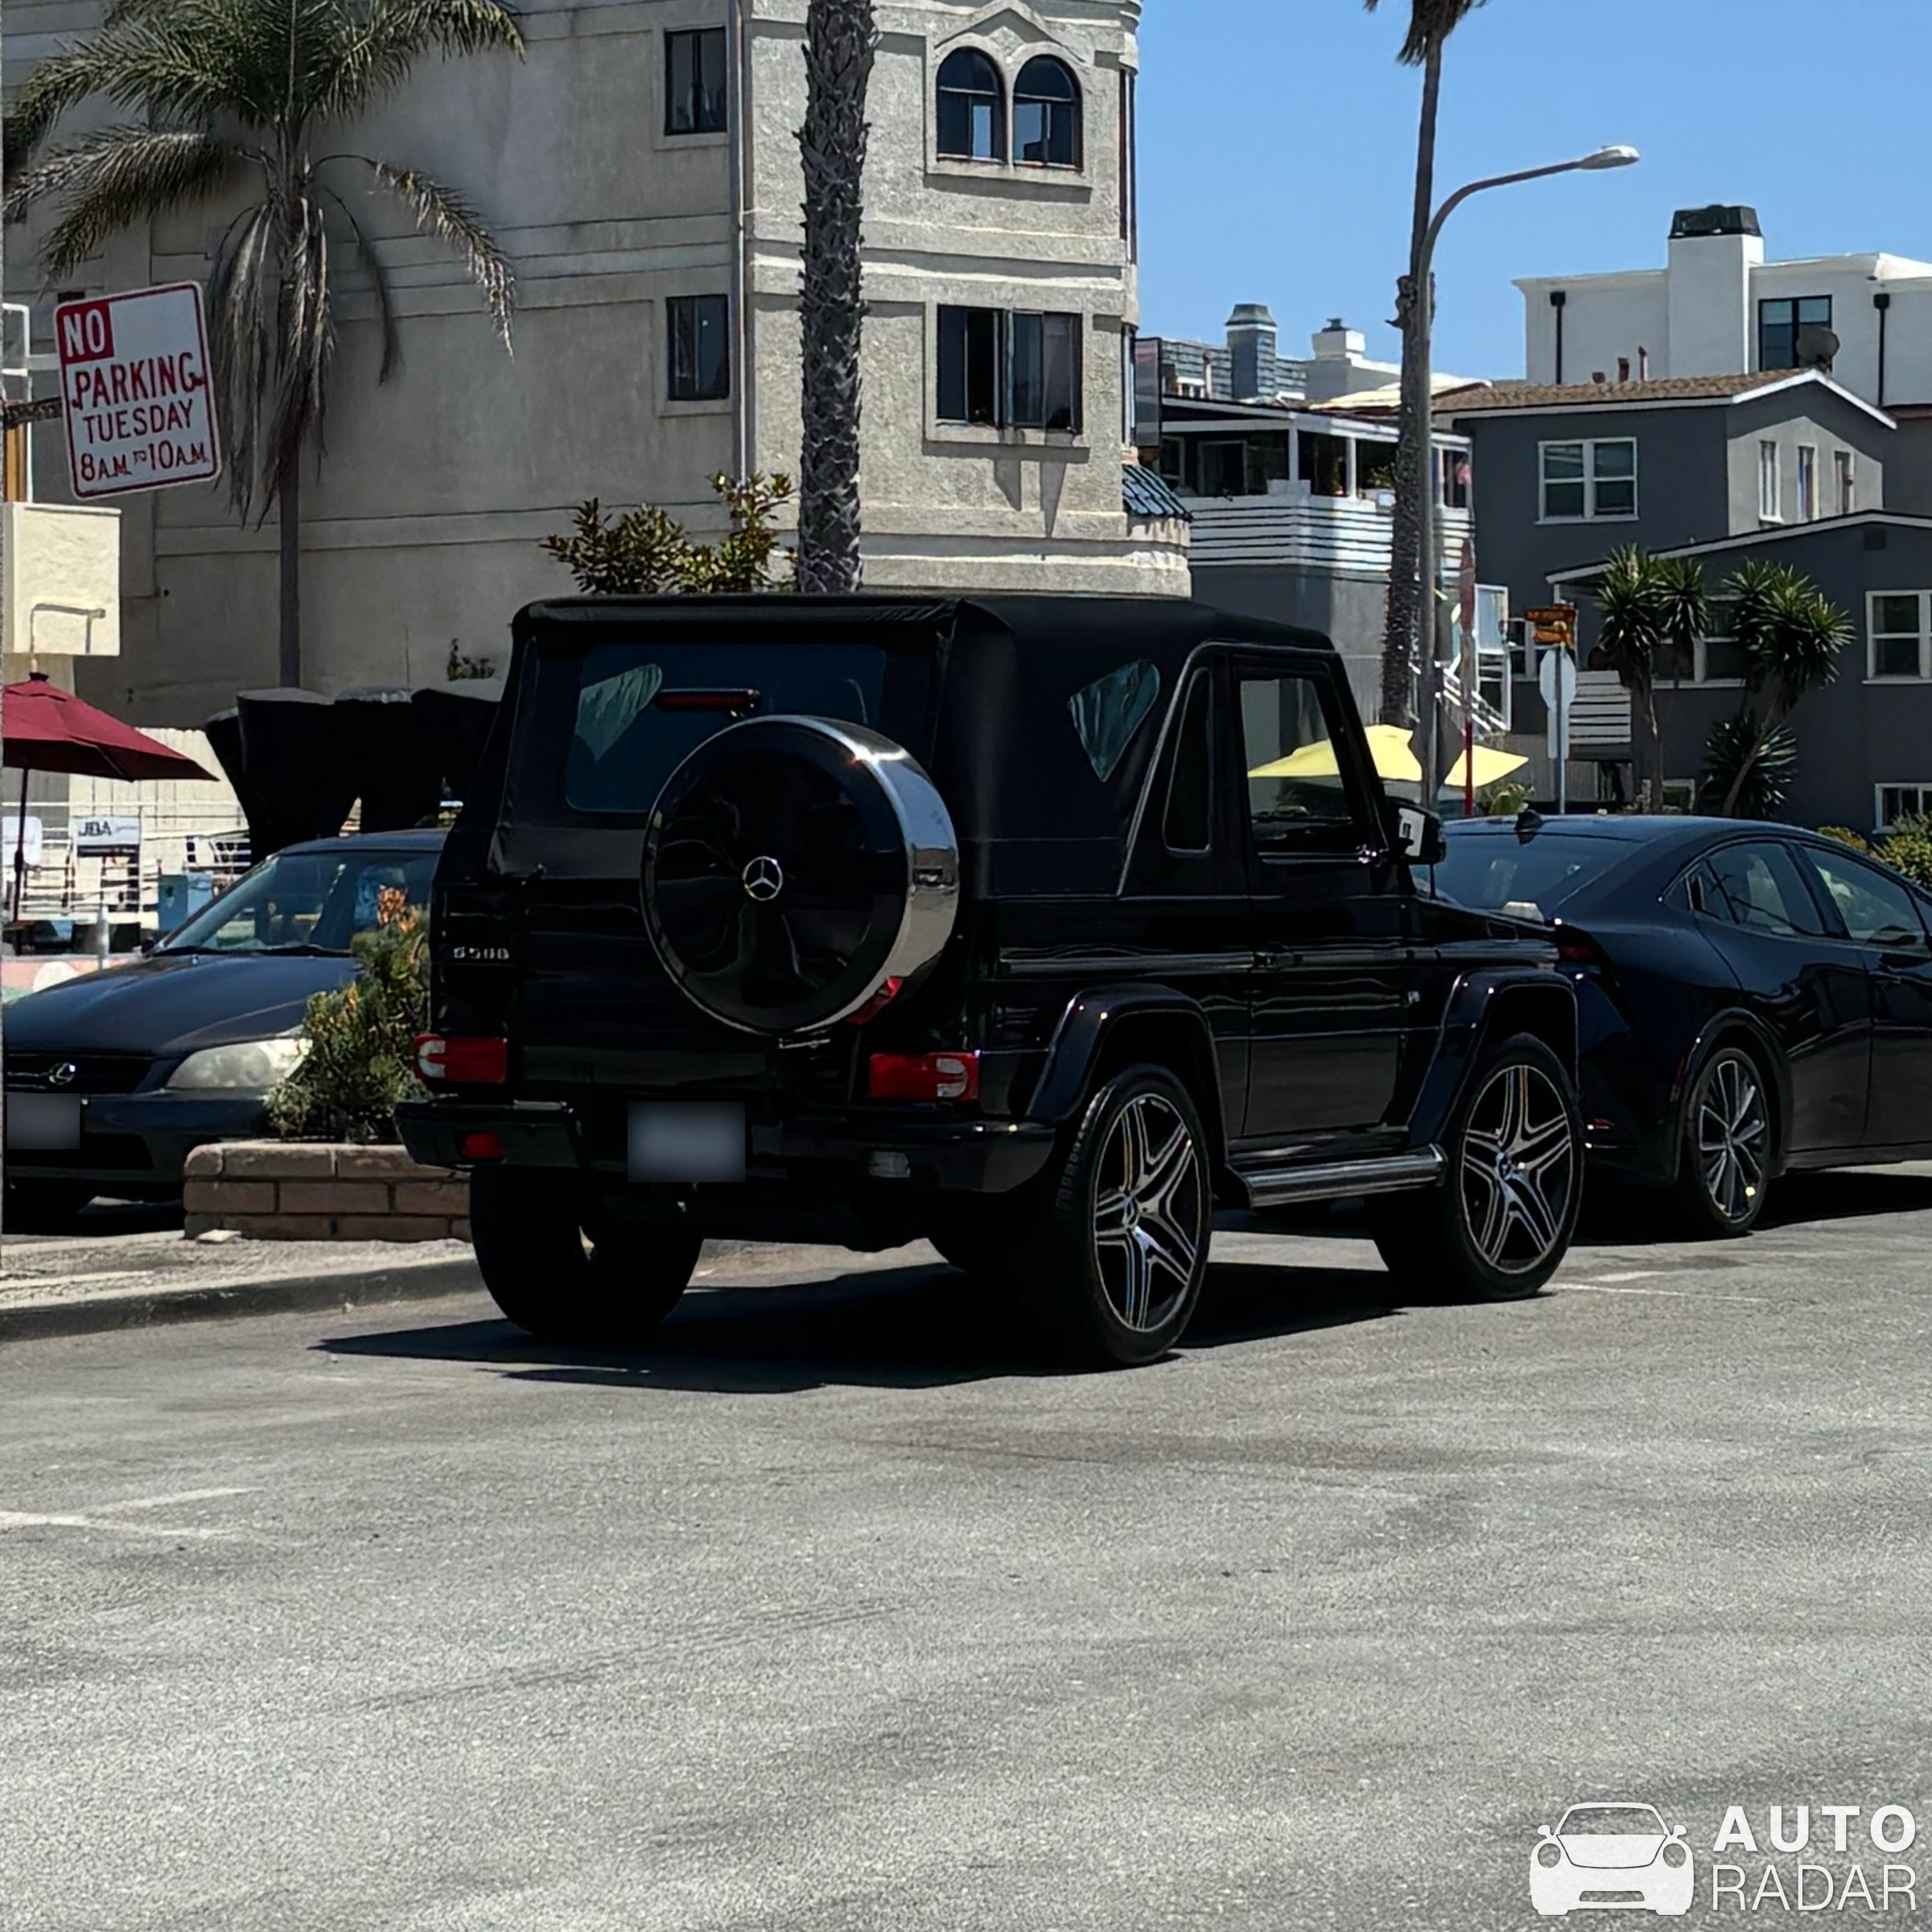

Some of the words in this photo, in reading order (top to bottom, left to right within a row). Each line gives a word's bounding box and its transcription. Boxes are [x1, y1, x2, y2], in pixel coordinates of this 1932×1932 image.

[63, 309, 105, 356] NO
[75, 352, 196, 410] PARKING
[83, 399, 193, 443] TUESDAY
